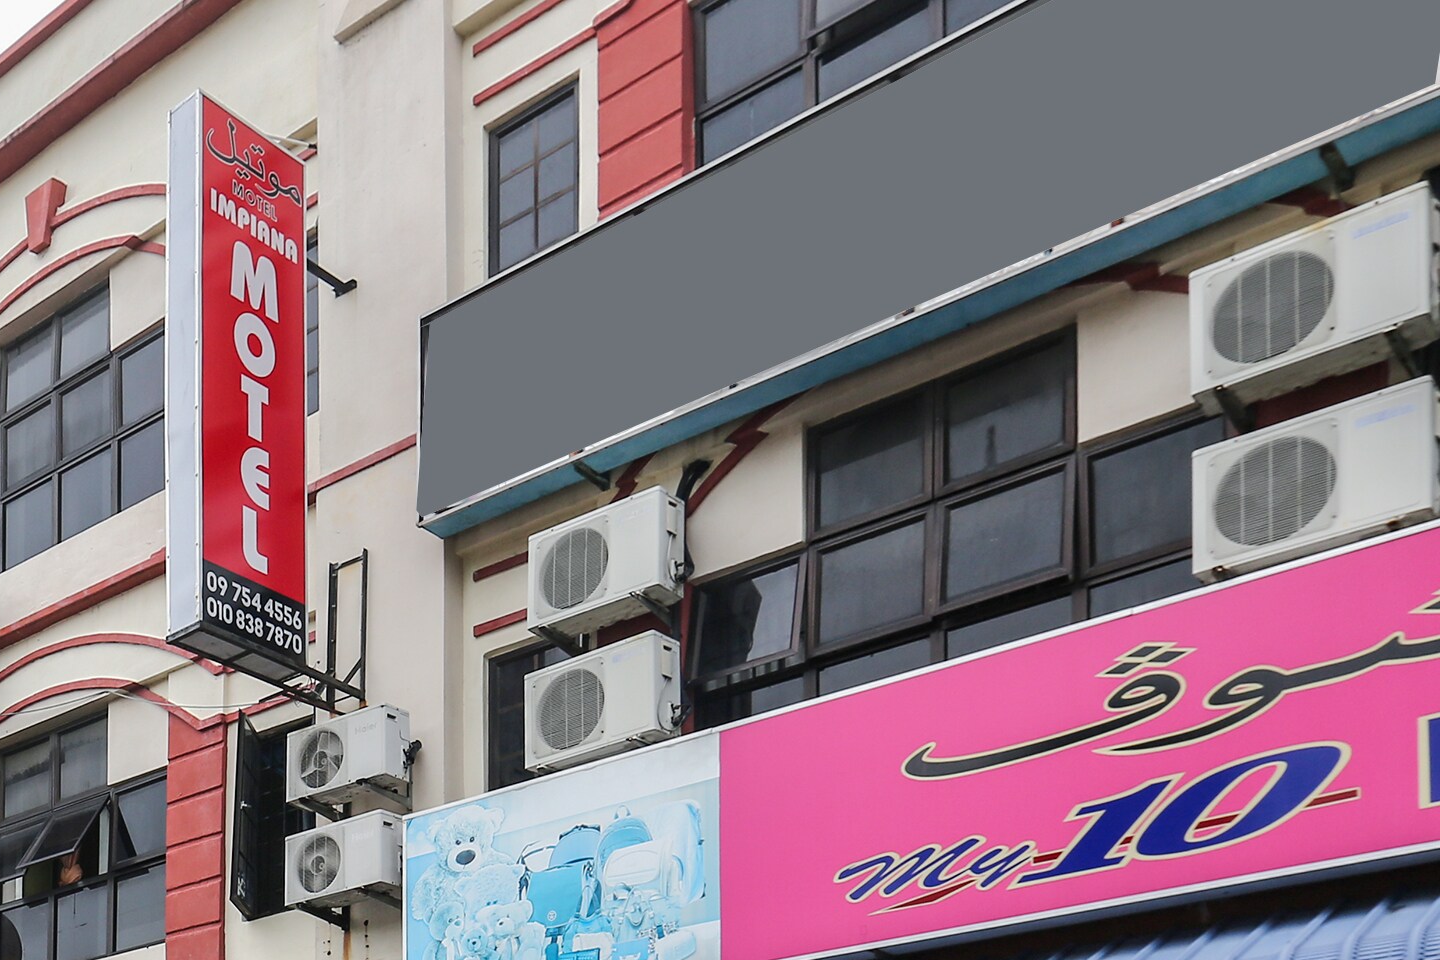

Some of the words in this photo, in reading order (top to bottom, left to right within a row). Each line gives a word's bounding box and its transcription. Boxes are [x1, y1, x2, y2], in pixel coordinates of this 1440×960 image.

[210, 188, 298, 265] IMPIANA
[232, 179, 277, 222] MOTEL
[229, 239, 279, 576] MOTEL
[206, 571, 228, 596] 09
[232, 581, 262, 612] 754
[264, 598, 302, 630] 4556
[206, 597, 233, 624] 010
[236, 609, 263, 638] 838
[265, 621, 302, 654] 7870
